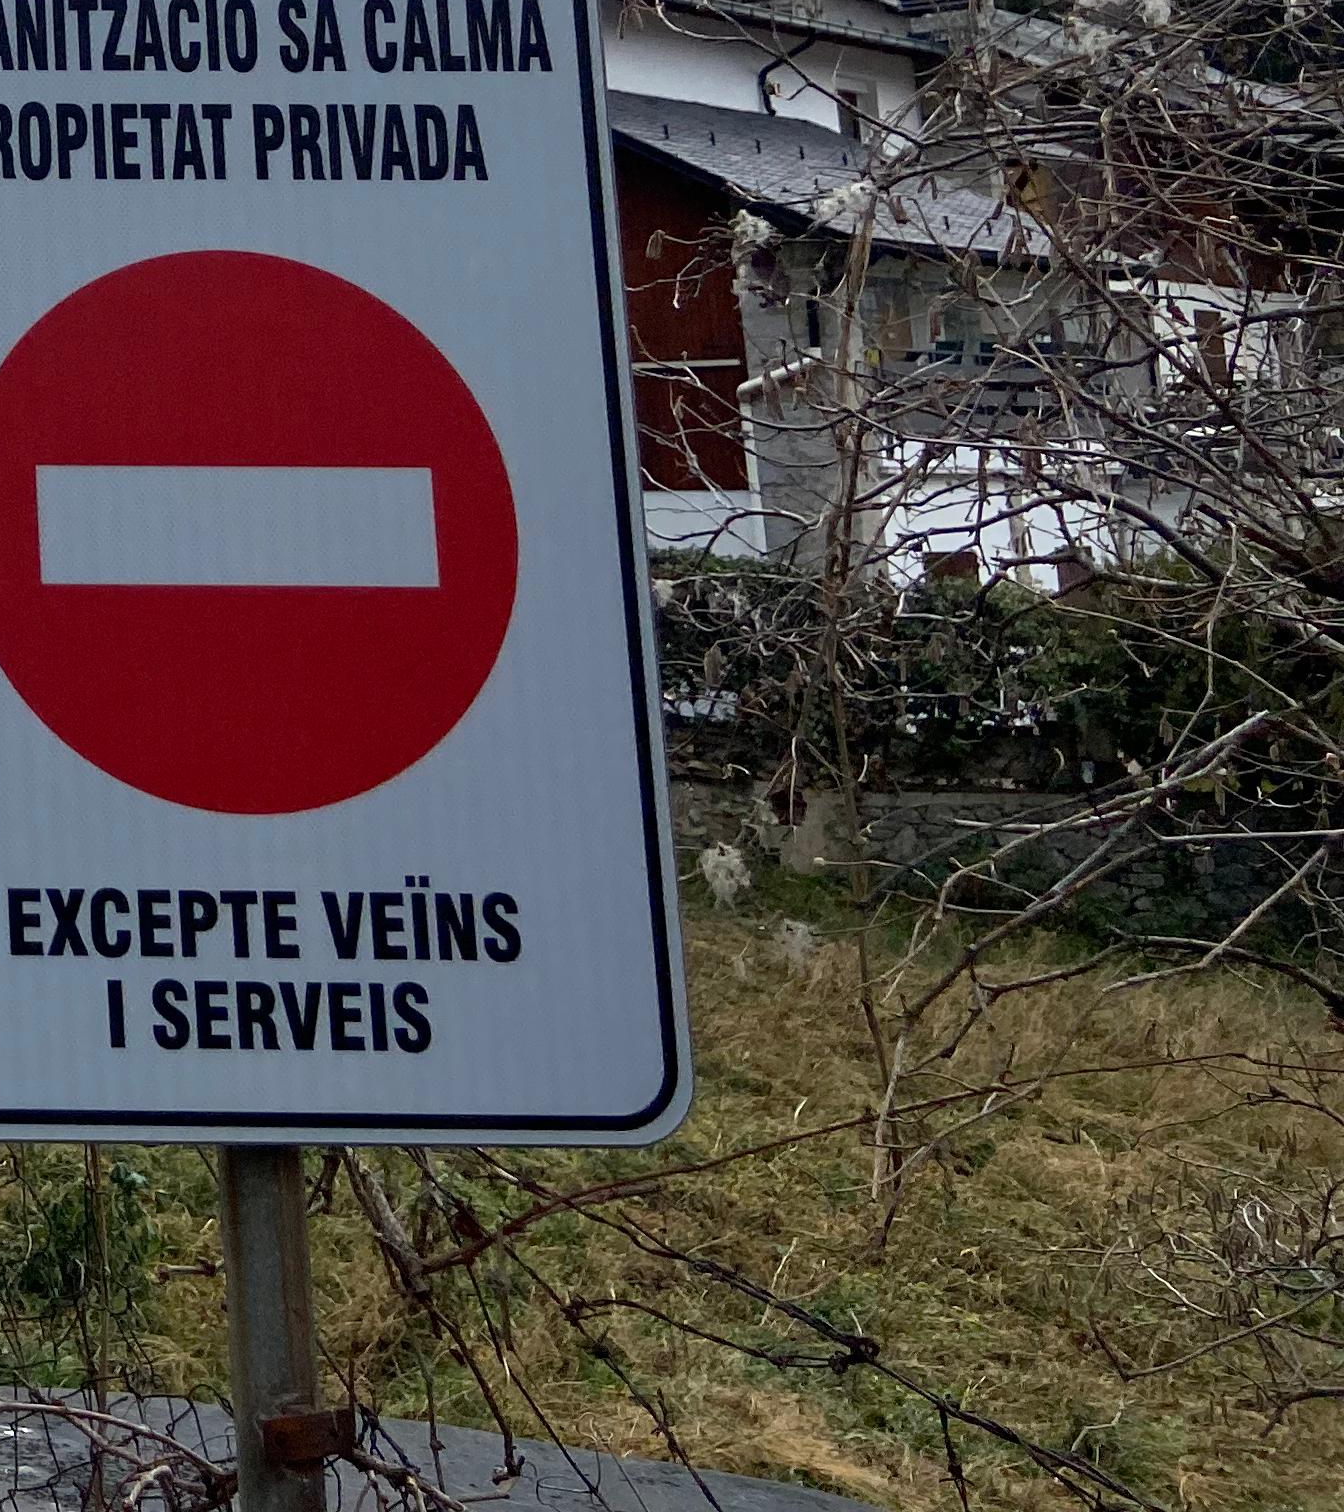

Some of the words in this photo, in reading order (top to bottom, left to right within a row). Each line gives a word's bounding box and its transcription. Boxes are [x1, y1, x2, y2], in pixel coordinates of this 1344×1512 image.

[253, 104, 488, 180] PRIVADA
[8, 888, 300, 958] EXCEPTE
[321, 876, 521, 962] VEÏNS
[108, 980, 125, 1048] I
[152, 979, 431, 1053] SERVEIS
